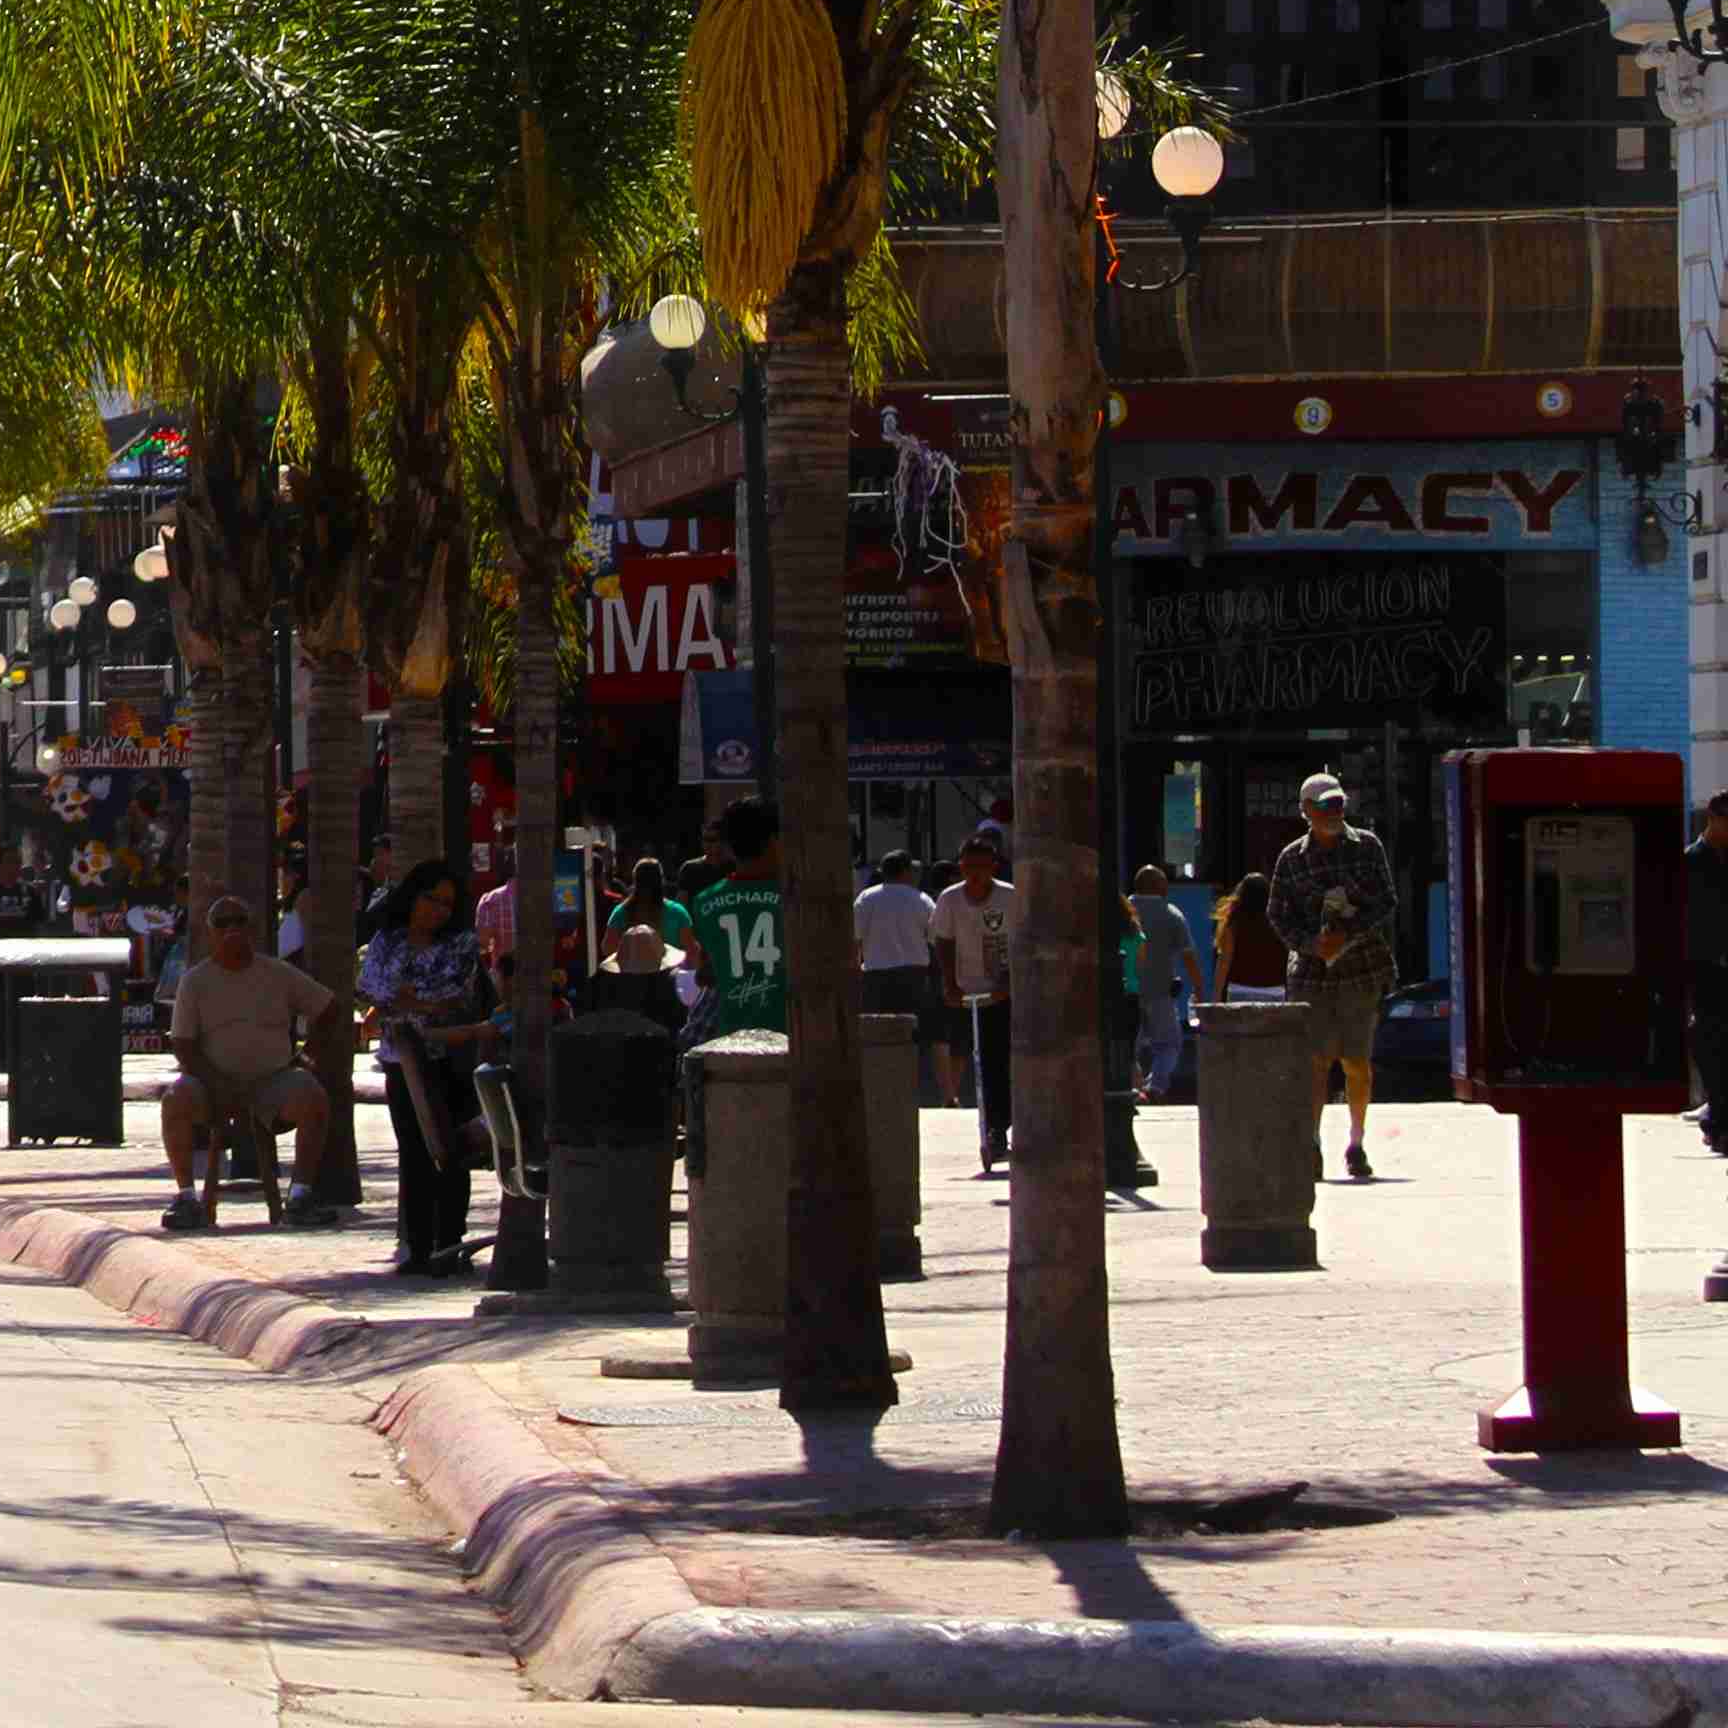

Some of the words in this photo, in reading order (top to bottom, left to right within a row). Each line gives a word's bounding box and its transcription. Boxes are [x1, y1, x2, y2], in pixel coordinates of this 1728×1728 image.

[586, 582, 730, 674] MA
[1144, 562, 1452, 643] REVOLUCION
[1134, 624, 1494, 726] PHARMACY
[718, 911, 783, 978] 14
